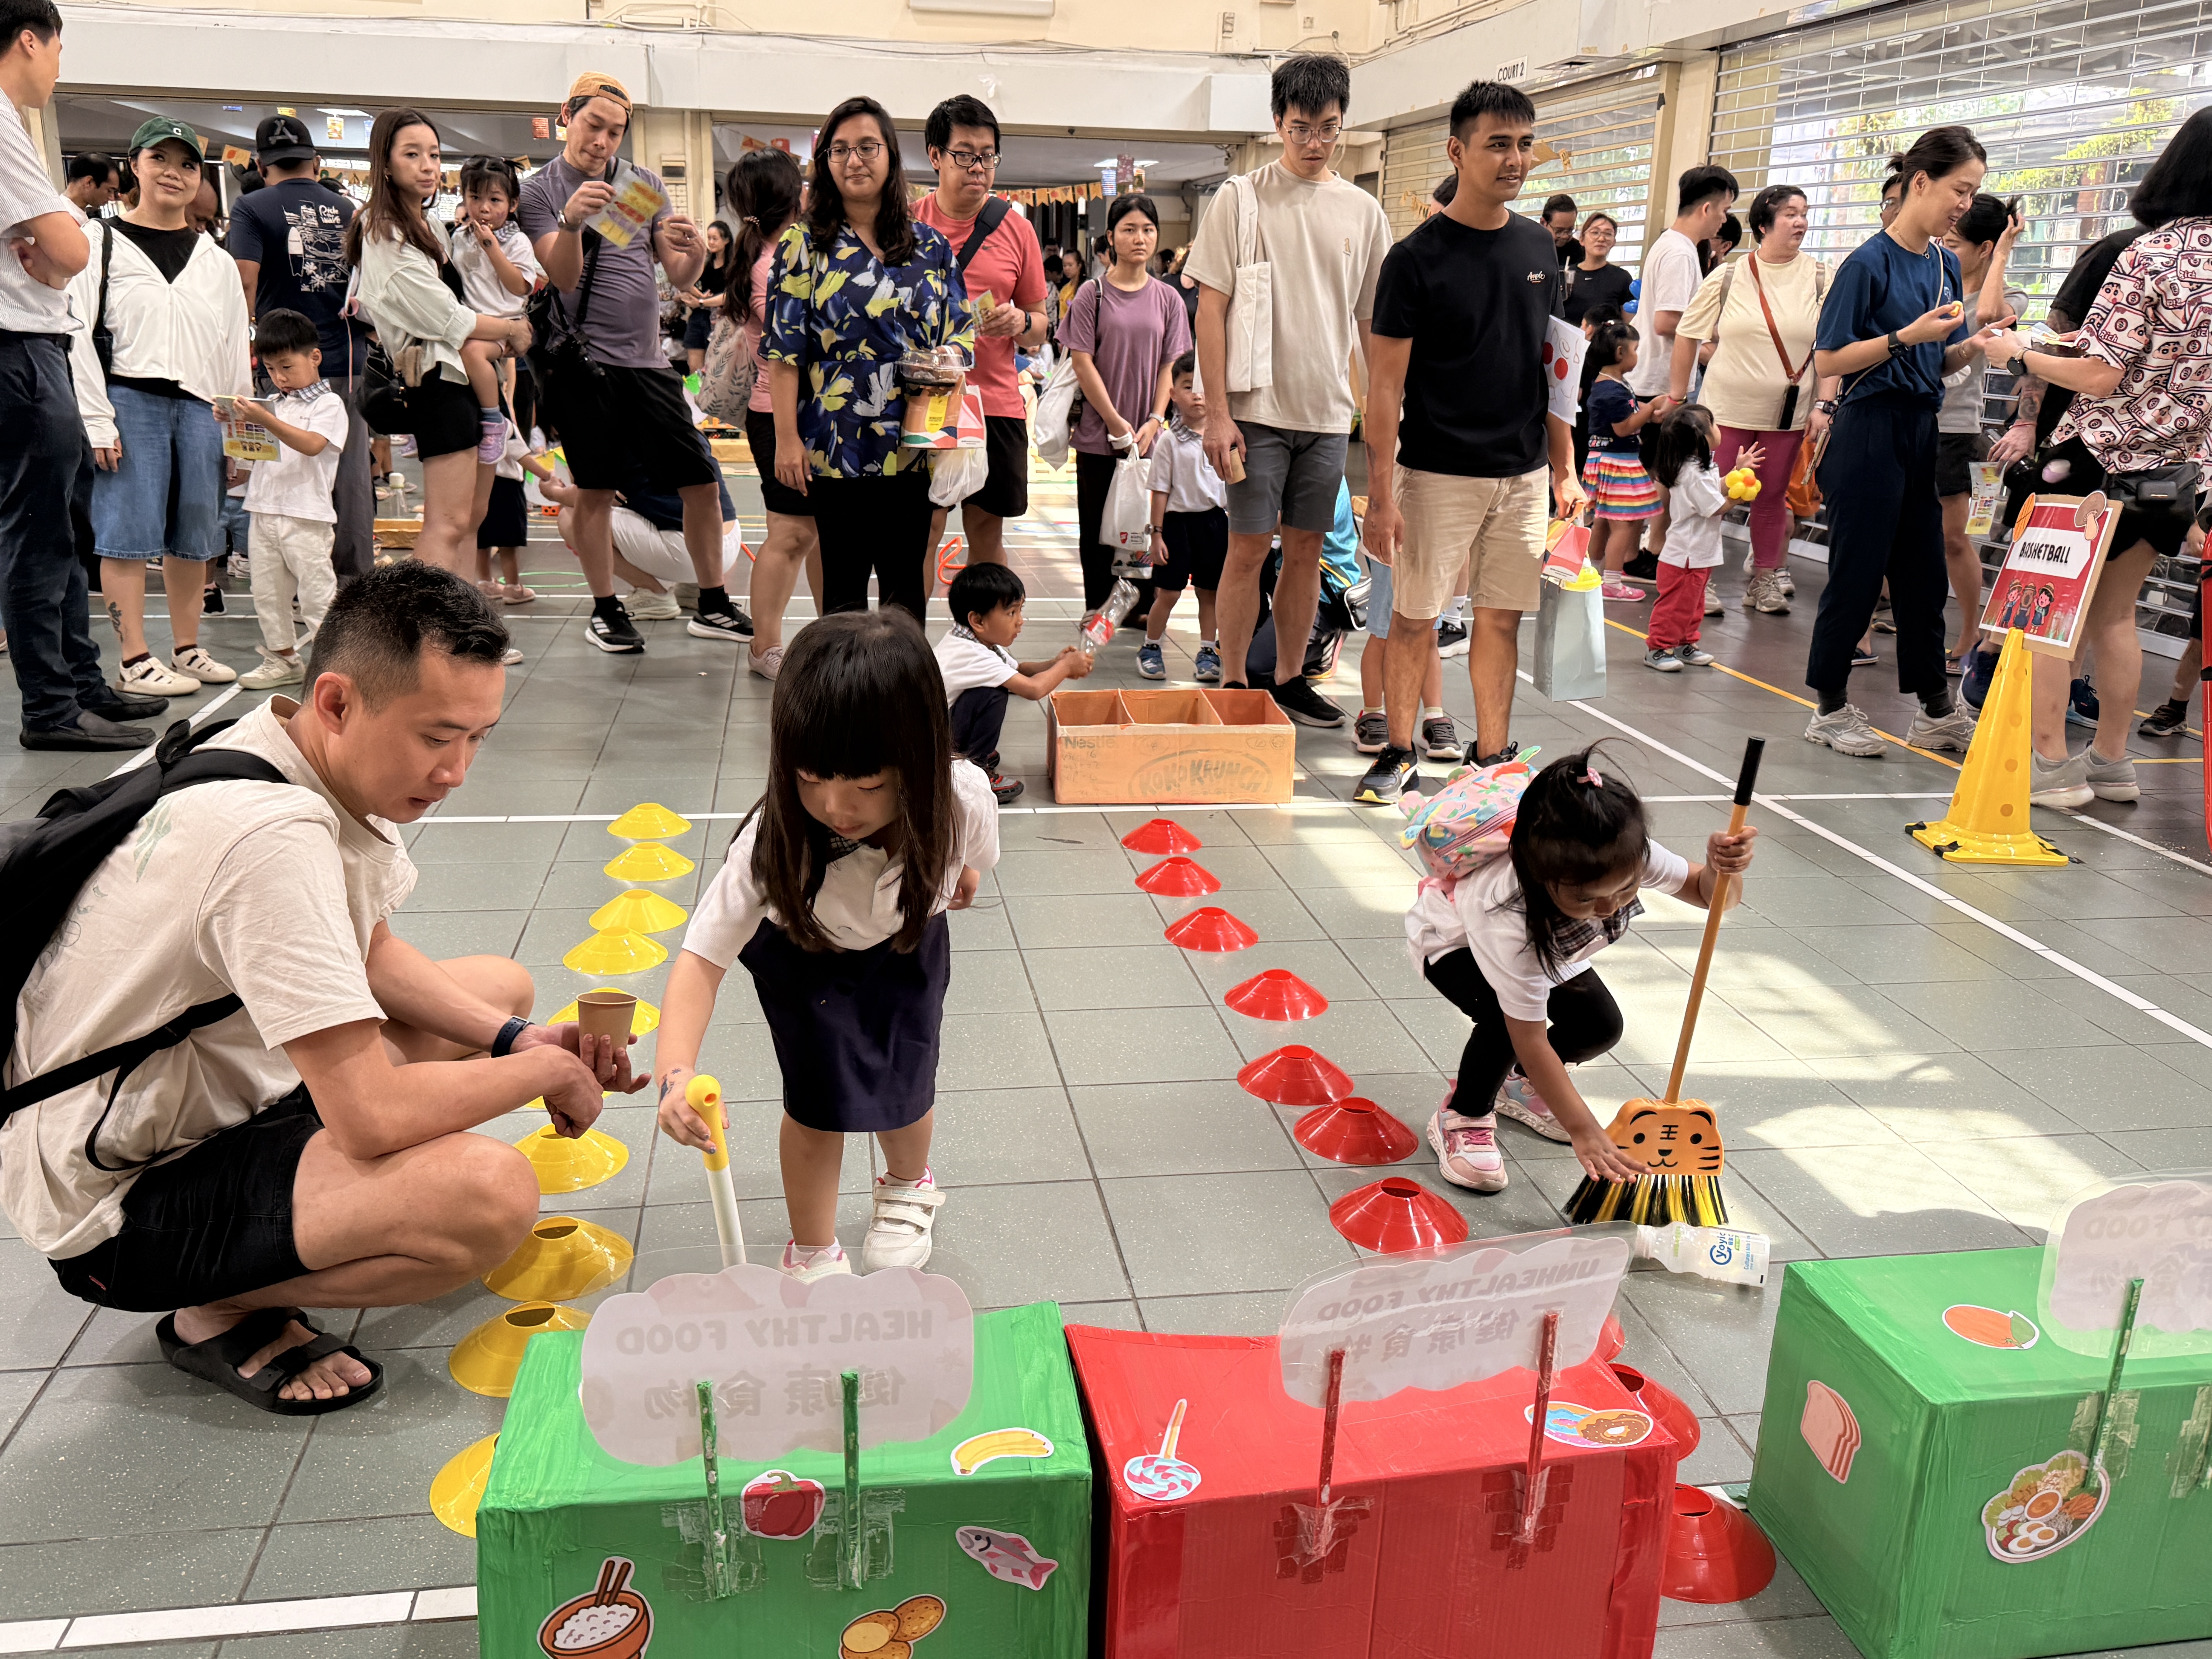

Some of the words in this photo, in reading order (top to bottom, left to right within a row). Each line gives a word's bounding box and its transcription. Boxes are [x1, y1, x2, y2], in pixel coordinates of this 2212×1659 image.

[1498, 64, 1519, 82] COURT
[1520, 62, 1524, 76] 2
[319, 205, 340, 216] Ride
[2098, 330, 2118, 343] Rich
[2019, 542, 2071, 563] BASKETBALL
